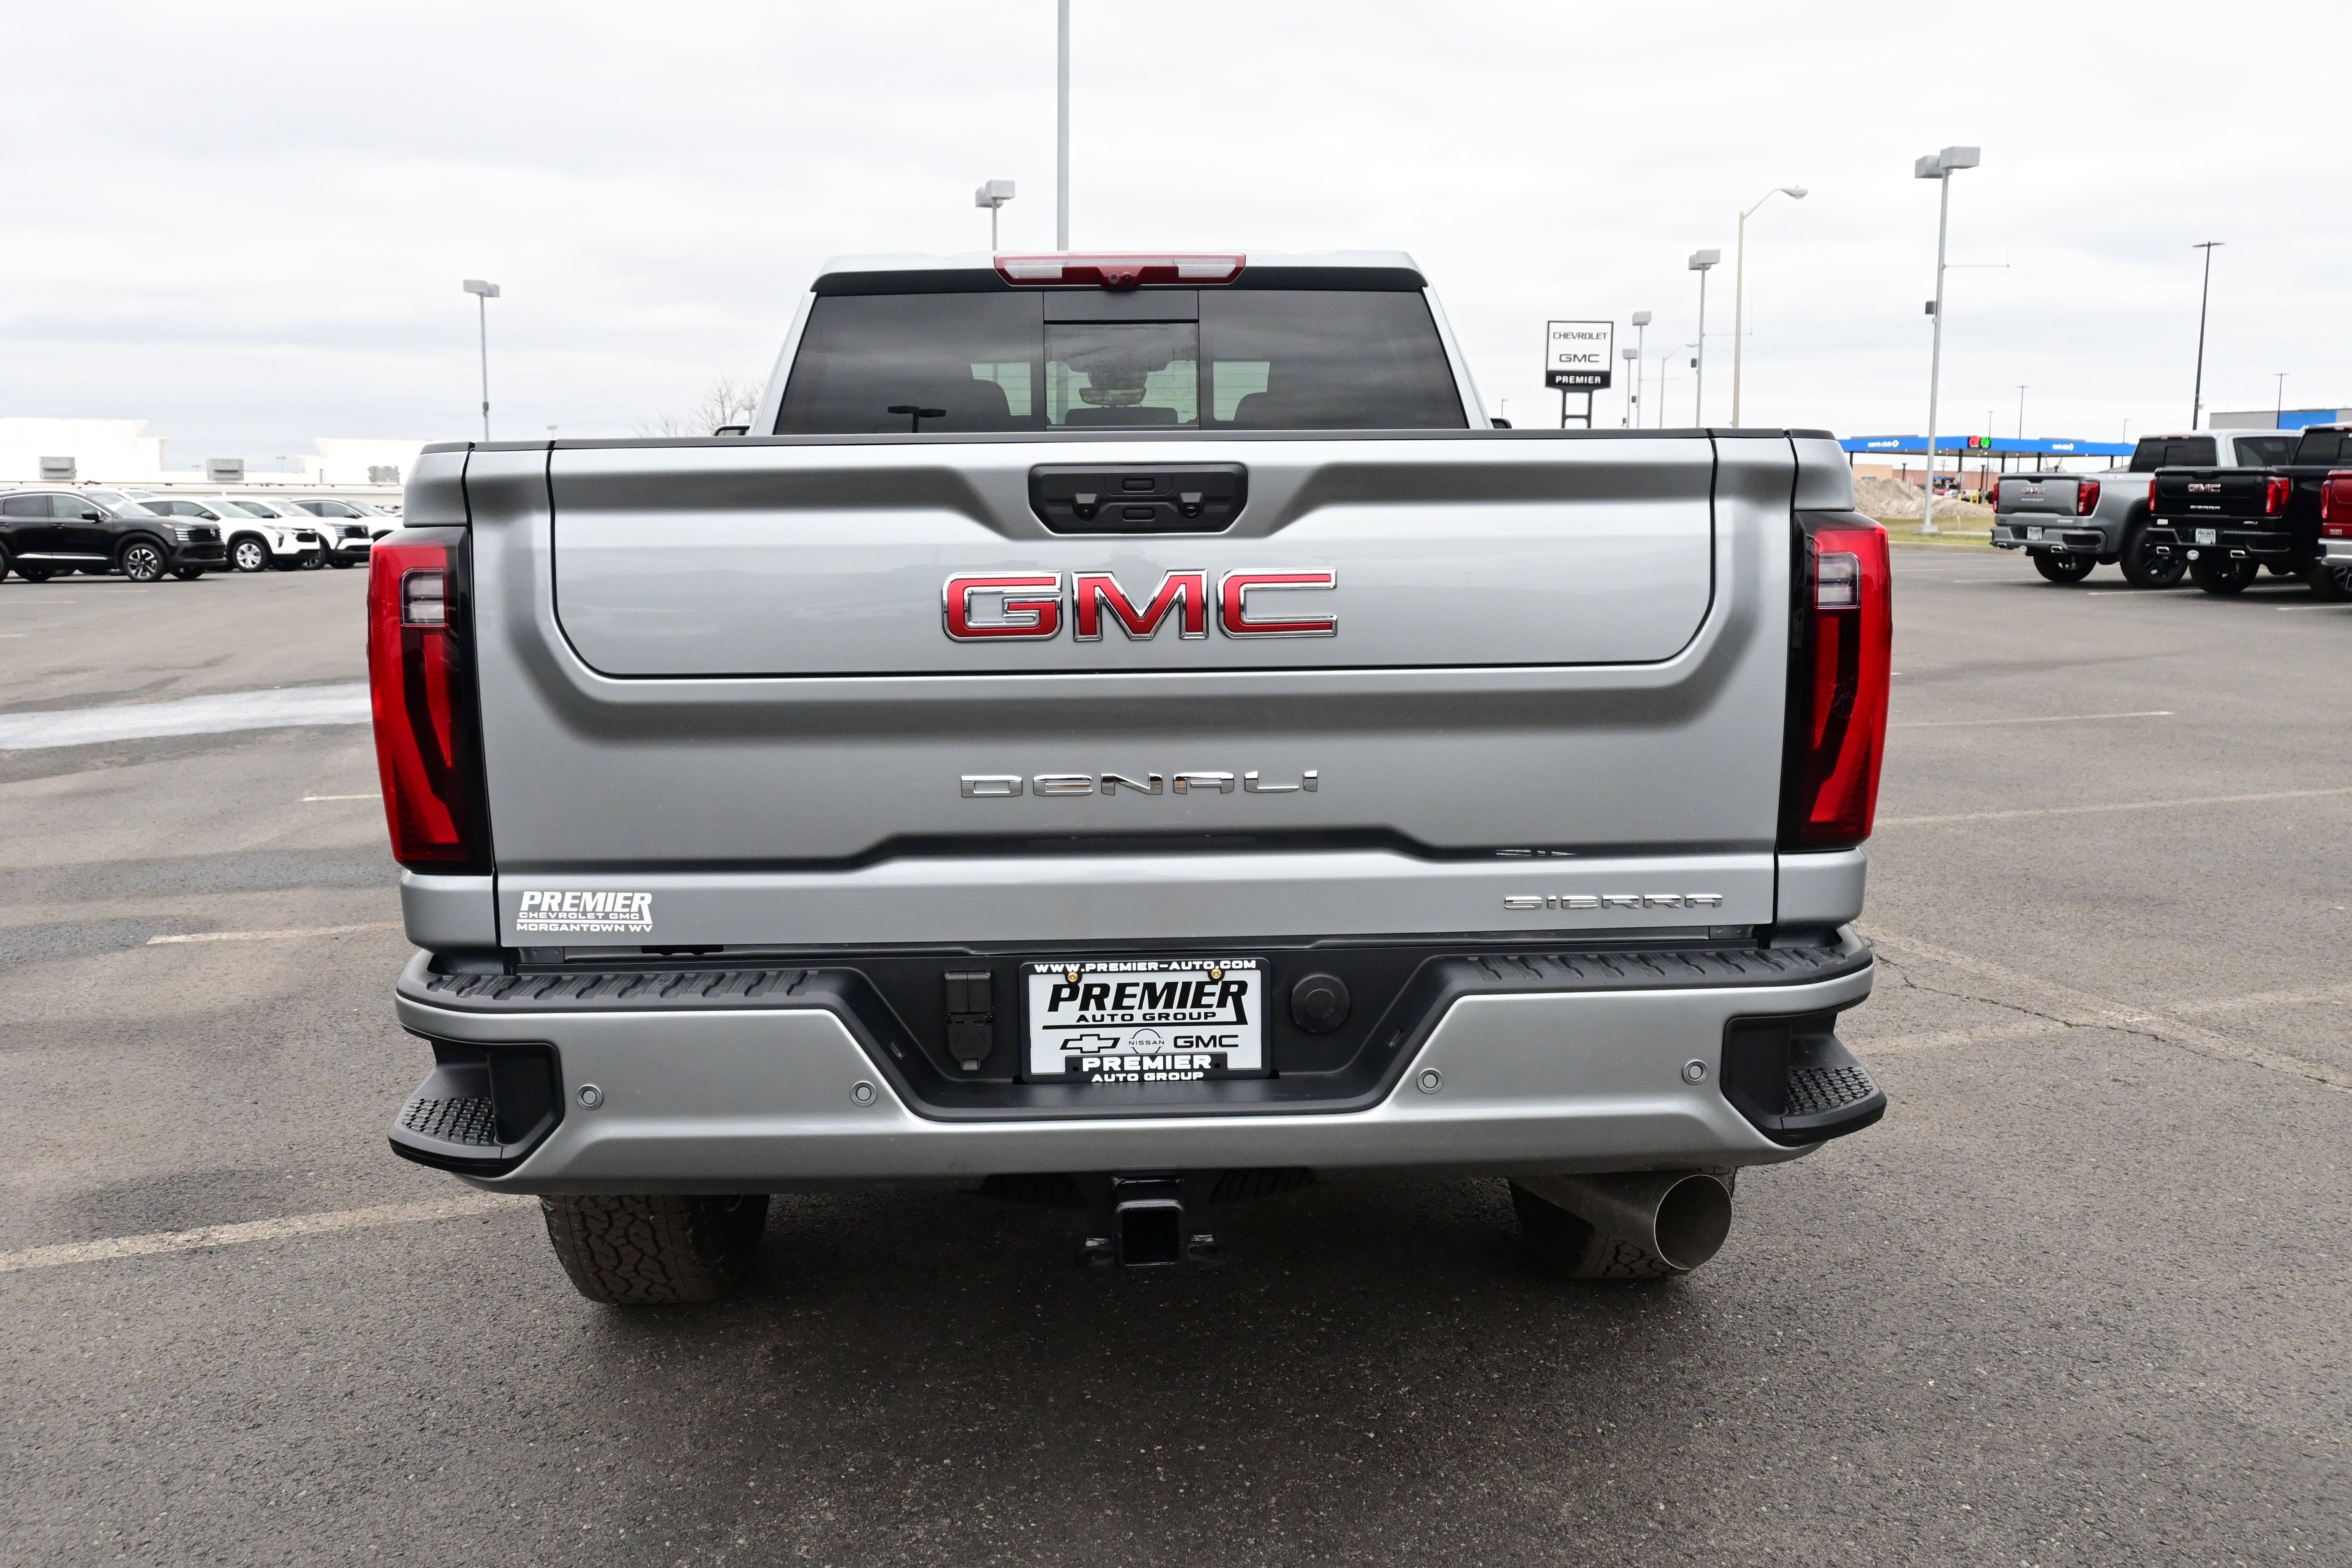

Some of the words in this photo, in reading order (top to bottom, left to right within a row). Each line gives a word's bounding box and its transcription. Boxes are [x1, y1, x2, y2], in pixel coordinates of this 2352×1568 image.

[1553, 332, 1608, 340] CHEVROLET
[1559, 354, 1600, 362] GMC
[1555, 376, 1601, 384] PREMIER
[2188, 484, 2221, 492] GMC
[941, 568, 1338, 642] GMC
[961, 770, 1318, 798] DENALI
[520, 891, 652, 912] PREMIER
[1504, 893, 1723, 910] SIERRA
[517, 923, 625, 932] MORGANTOWN
[629, 924, 653, 932] WV
[1034, 960, 1256, 973] WWW.PREMIER-AUTO.COM
[1047, 980, 1248, 1013] PREMIER
[1076, 1013, 1134, 1023] AUTO
[1142, 1012, 1217, 1021] GROUP
[1173, 1035, 1239, 1048] GMC
[1082, 1054, 1212, 1072] PREMIER
[1091, 1073, 1139, 1083] AUTO
[1143, 1072, 1204, 1081] GROUP
